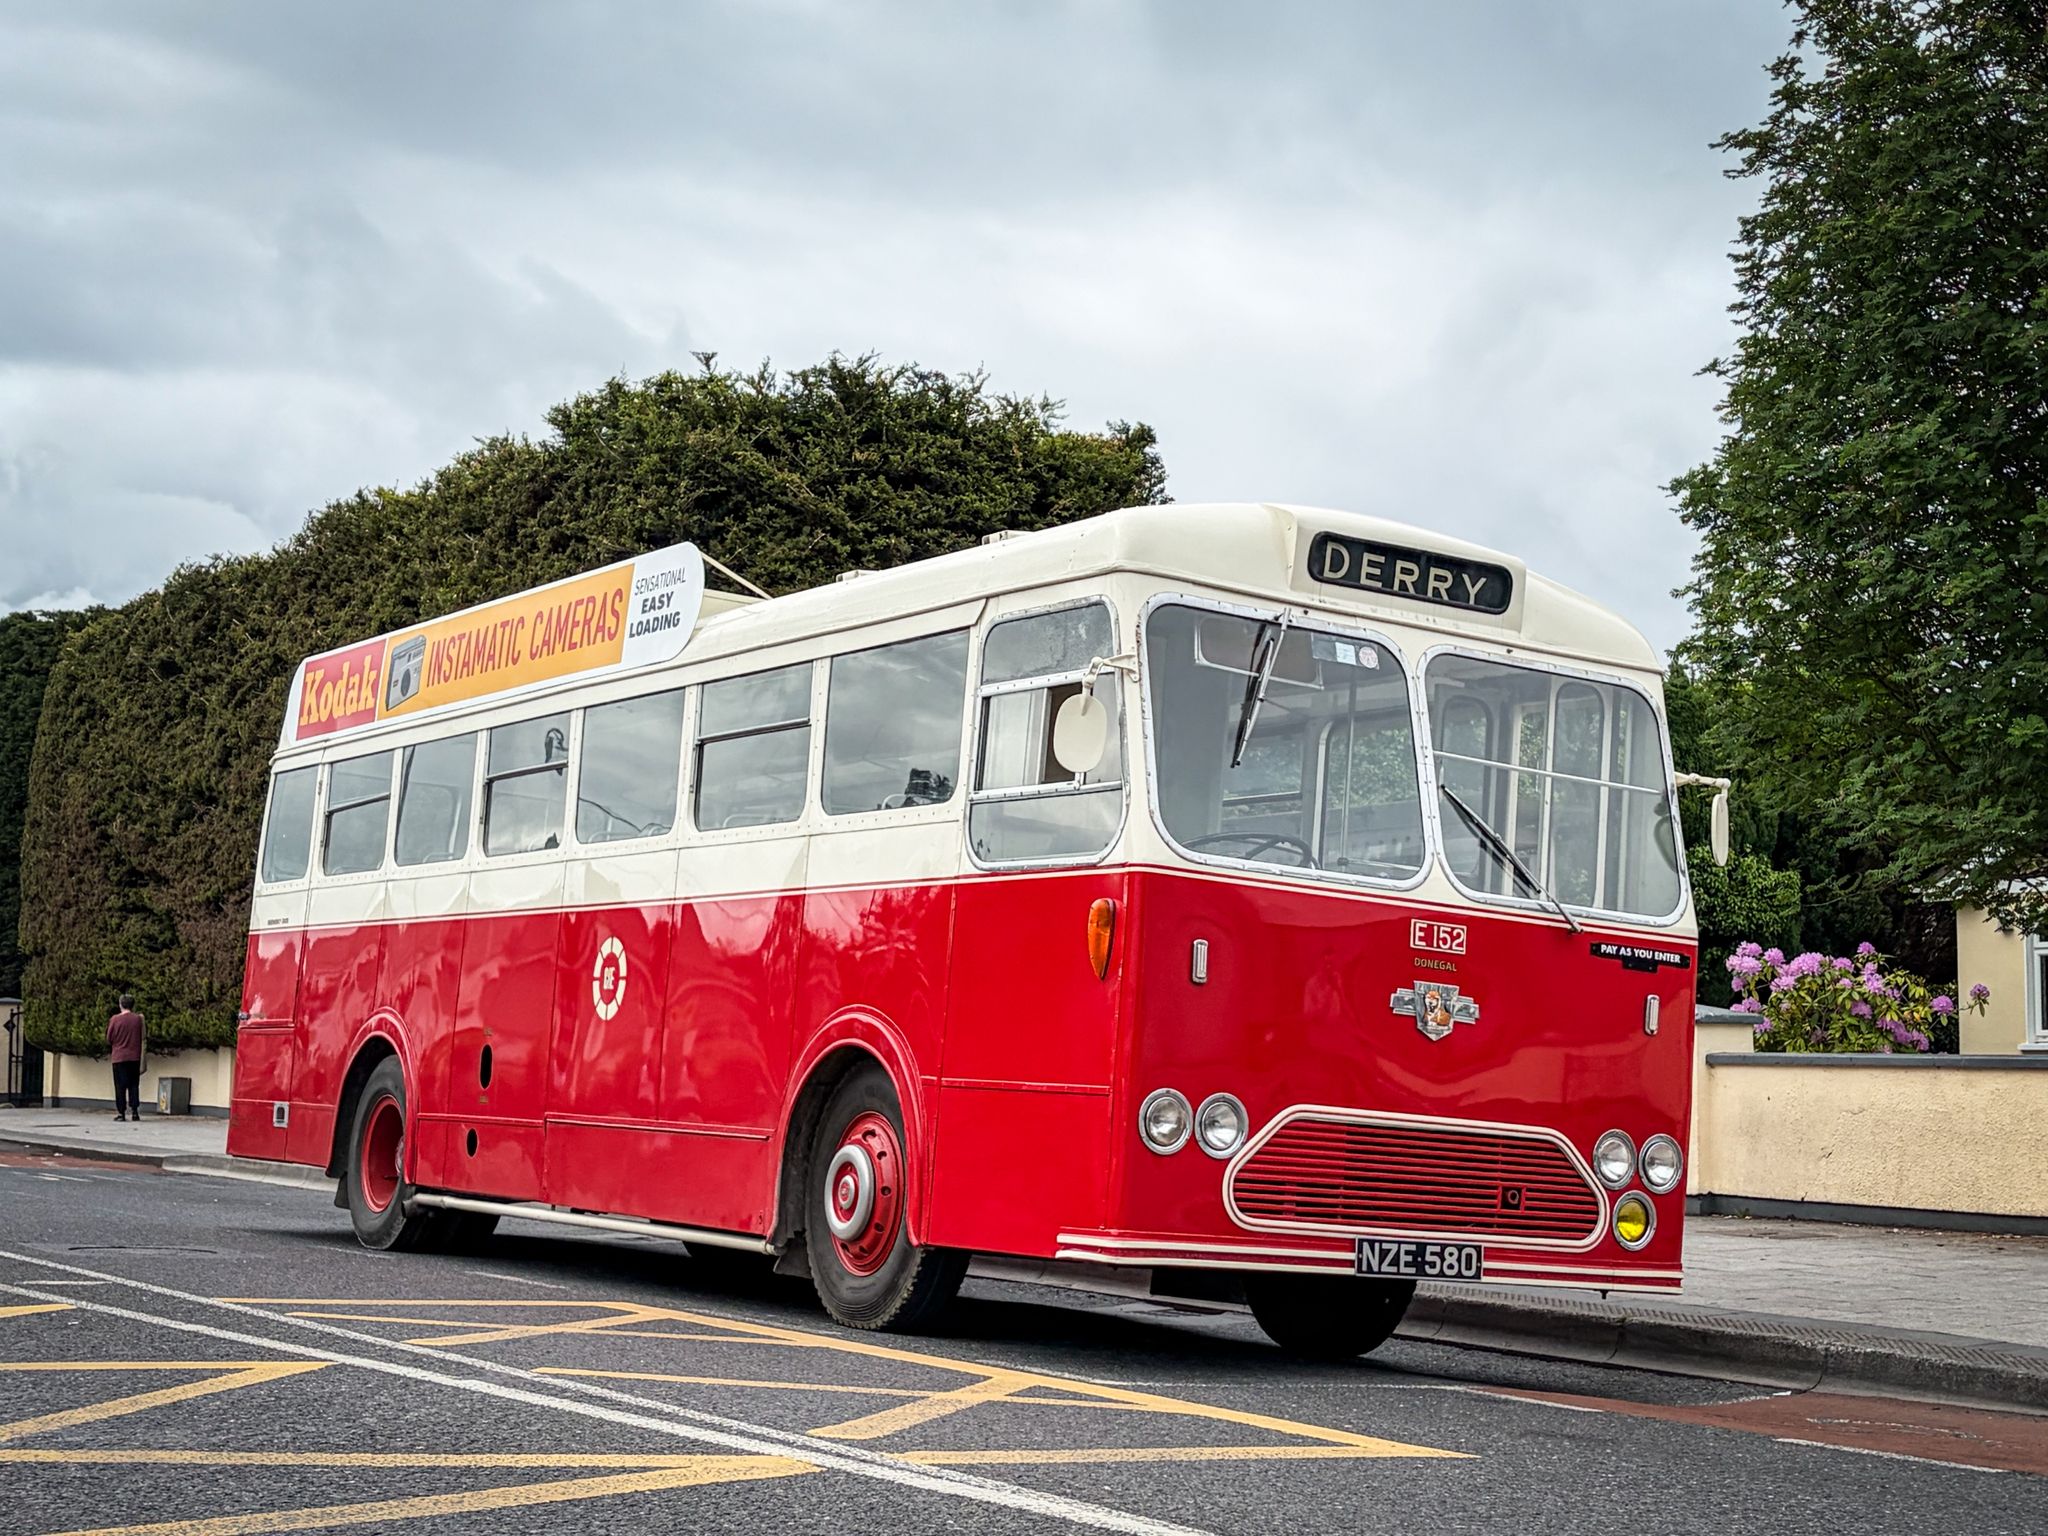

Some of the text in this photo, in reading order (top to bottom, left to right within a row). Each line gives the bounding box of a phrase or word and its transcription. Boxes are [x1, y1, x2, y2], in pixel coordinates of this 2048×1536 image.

[634, 567, 687, 596] SENSATIONAL
[1322, 541, 1487, 605] DERRY
[641, 590, 674, 614] EASY
[628, 611, 681, 638] LOADING
[299, 588, 624, 727] Kodak INSTAMATIC CAMERAS
[1414, 922, 1465, 951] E 152
[1414, 957, 1457, 972] DONEGAL
[1600, 944, 1681, 964] PAY AS YOU ENTER
[1361, 1241, 1478, 1277] NZE 580
